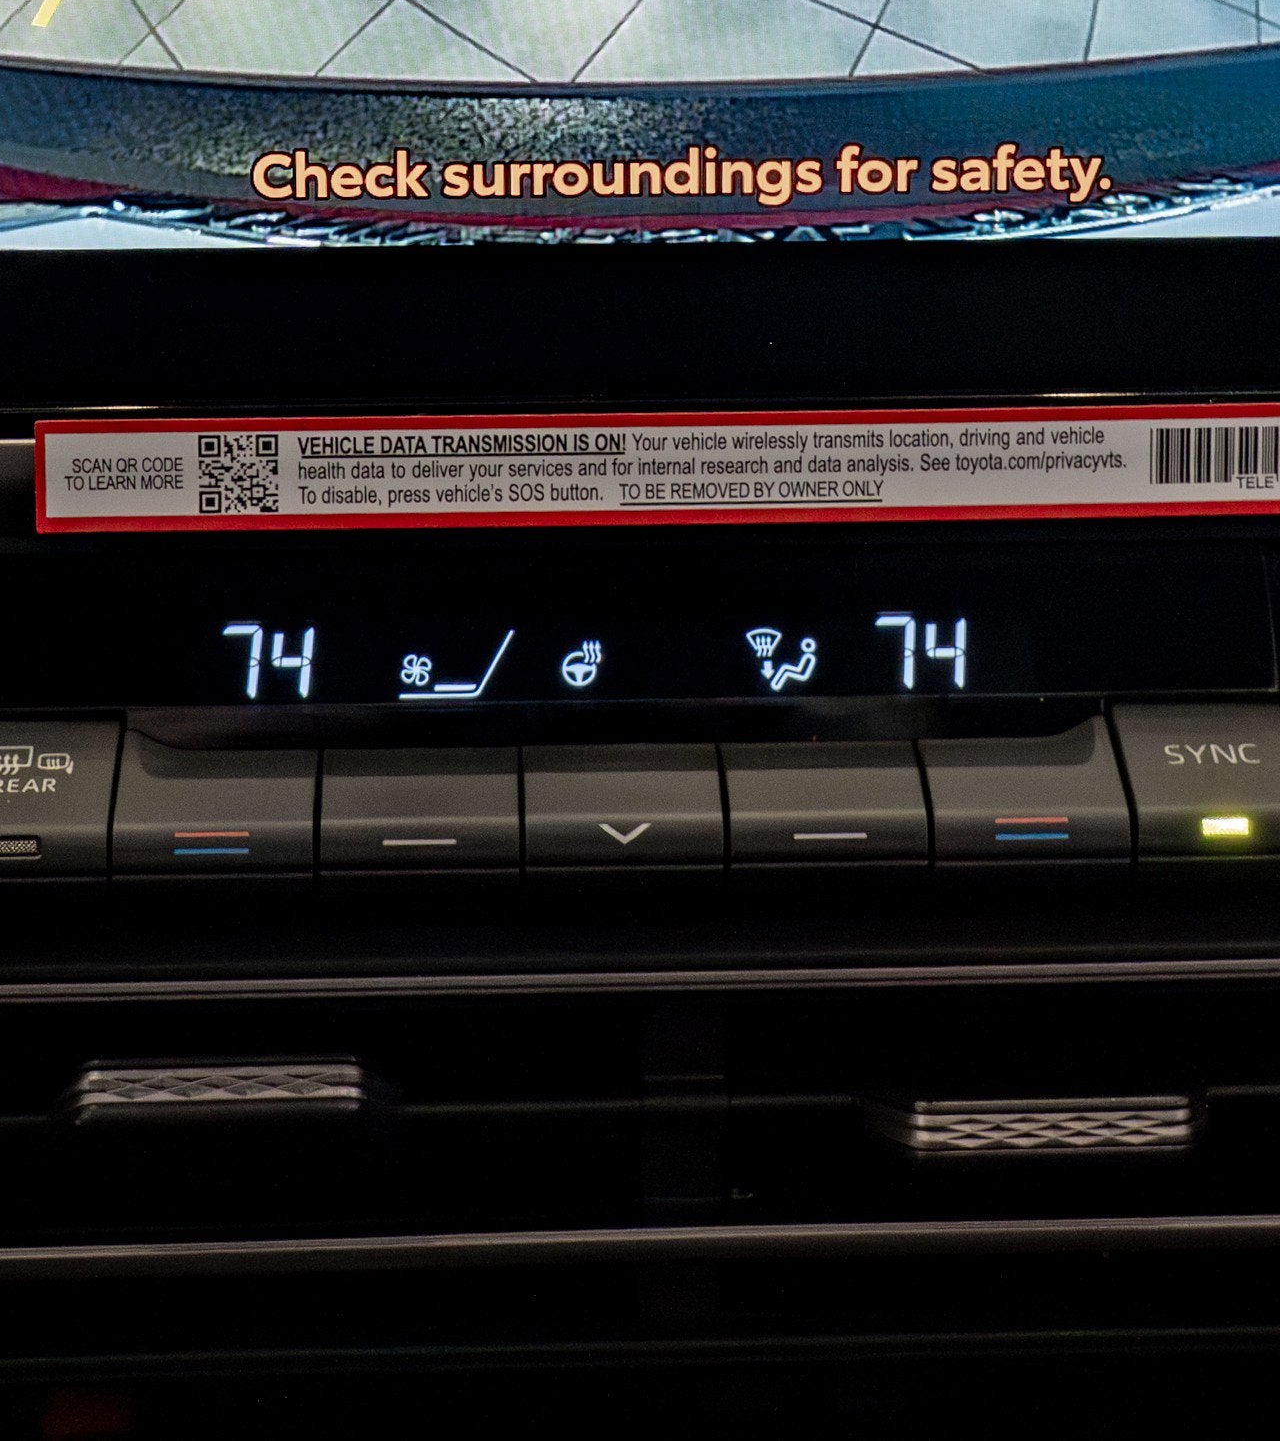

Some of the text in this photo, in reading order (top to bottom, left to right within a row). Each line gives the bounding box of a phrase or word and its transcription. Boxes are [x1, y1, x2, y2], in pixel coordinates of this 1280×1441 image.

[251, 142, 1113, 206] Check surroundings for safety.
[297, 427, 1105, 455] VEHICLE DATA TRANSMISSION IS ON! Your vehicle wirelessly transmits location, driving and vehicle
[72, 457, 183, 473] SCAN QR CODE
[298, 451, 1127, 481] health data to deliver your services and for internal research and data analysis. See toyota.com/privacyvts.
[64, 475, 183, 491] TO LEARN MORE
[298, 480, 884, 508] To disable, press vehicle's SOS button. TO BE REMOVED BY OWNER ONLY
[1237, 475, 1274, 489] TELE
[222, 625, 314, 698] 74
[875, 615, 966, 690] 74
[1164, 744, 1260, 765] SYNC
